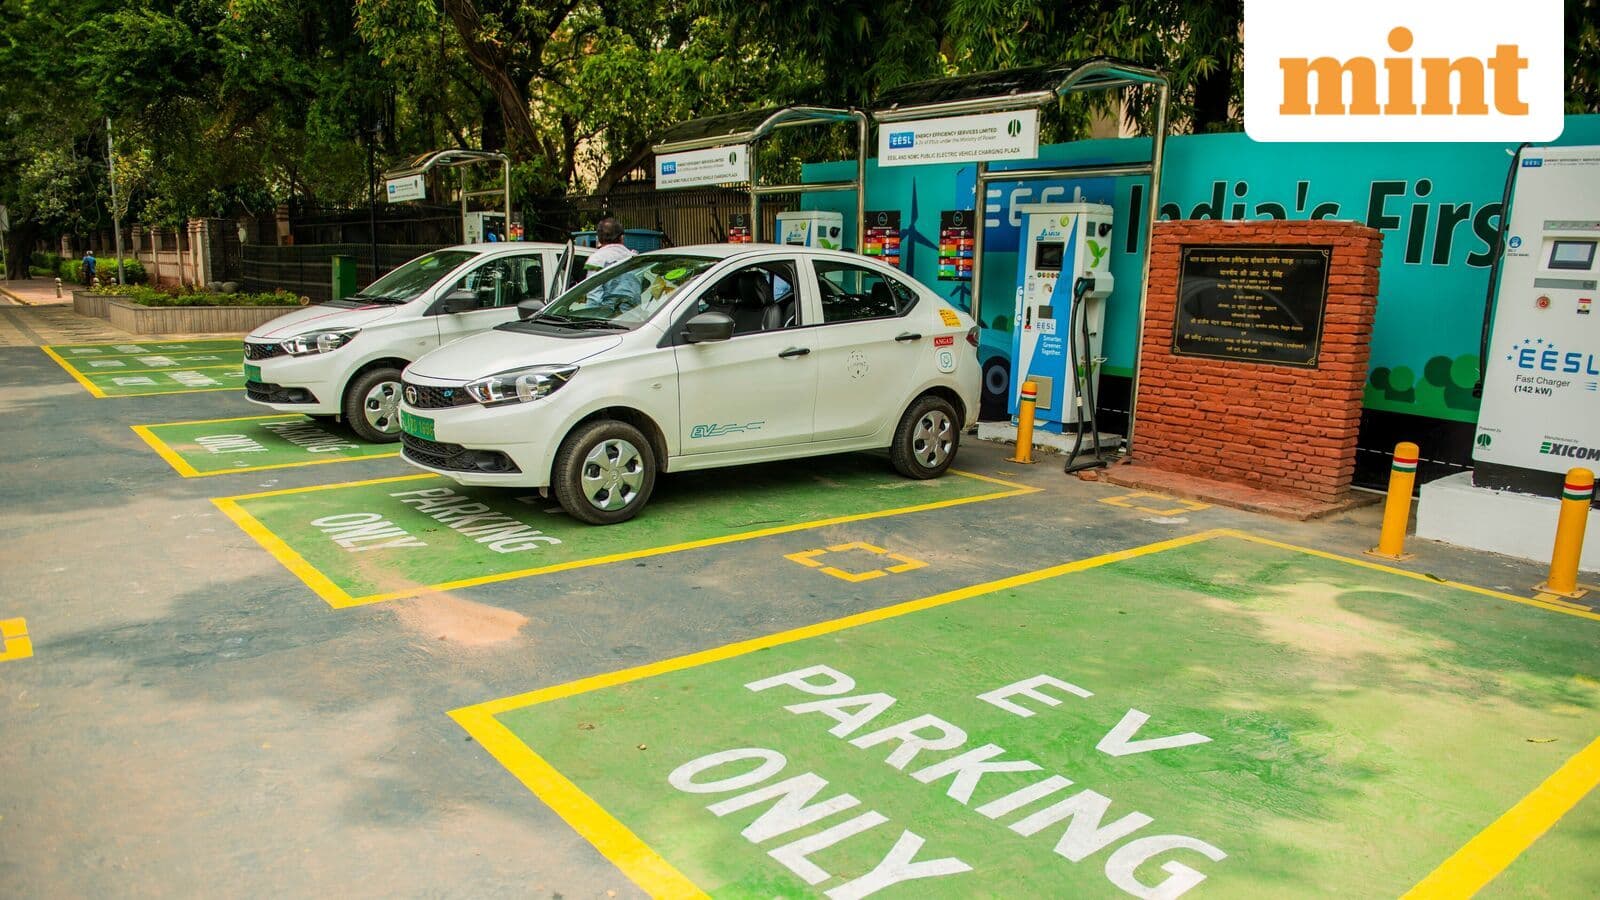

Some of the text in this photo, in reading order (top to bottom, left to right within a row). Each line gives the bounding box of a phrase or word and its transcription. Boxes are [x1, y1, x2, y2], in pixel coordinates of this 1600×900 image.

[932, 130, 957, 138] EFFICIENCY
[892, 137, 912, 146] EESL
[978, 148, 1004, 156] CHARGING
[1036, 322, 1055, 330] EESL
[1518, 349, 1599, 375] EESL
[1516, 375, 1571, 388] Fast Charger
[1514, 385, 1552, 397] (142 kW)
[691, 424, 717, 438] EV
[1540, 441, 1600, 461] EXICOM
[389, 487, 562, 553] PARKING
[310, 512, 428, 552] ONLY
[744, 664, 1228, 900] PARKING
[668, 747, 974, 900] ONLY
